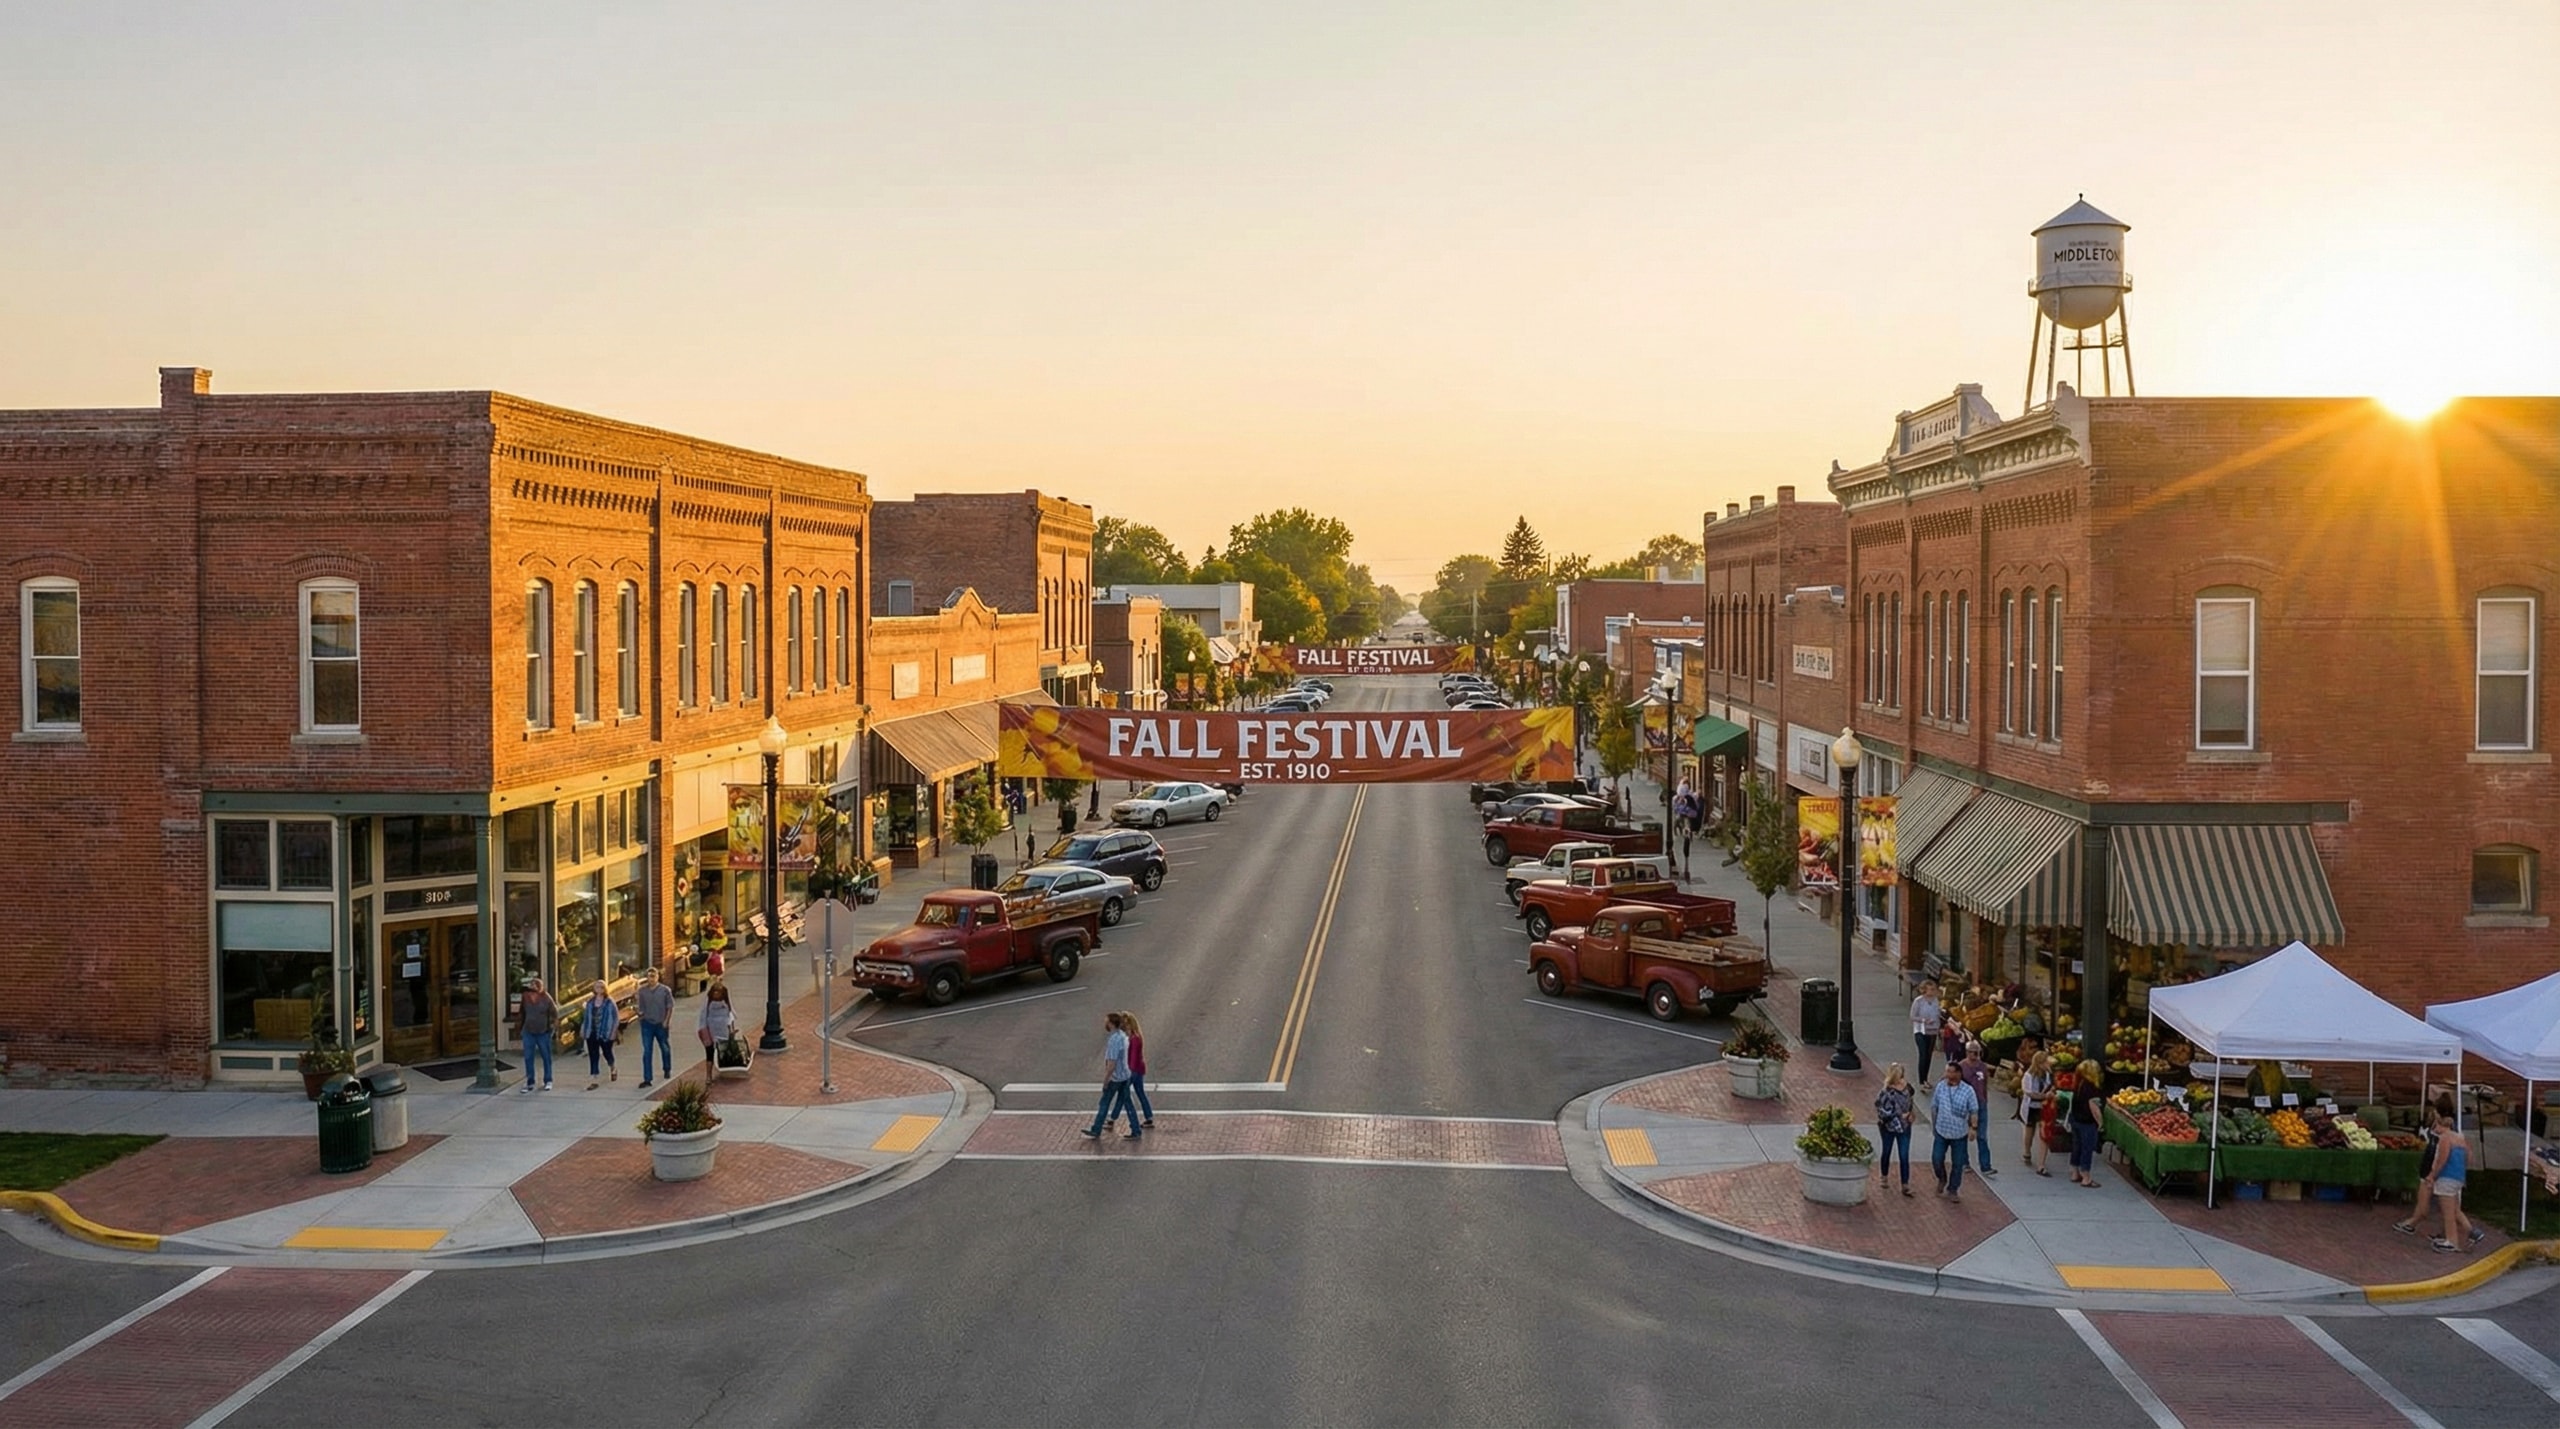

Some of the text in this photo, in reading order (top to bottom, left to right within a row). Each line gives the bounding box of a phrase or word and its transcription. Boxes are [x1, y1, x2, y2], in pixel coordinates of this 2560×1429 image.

[1297, 649, 1434, 666] FALL FESTIVAL
[1108, 717, 1464, 759] FALL FESTIVAL
[1239, 763, 1330, 779] EST. 1910
